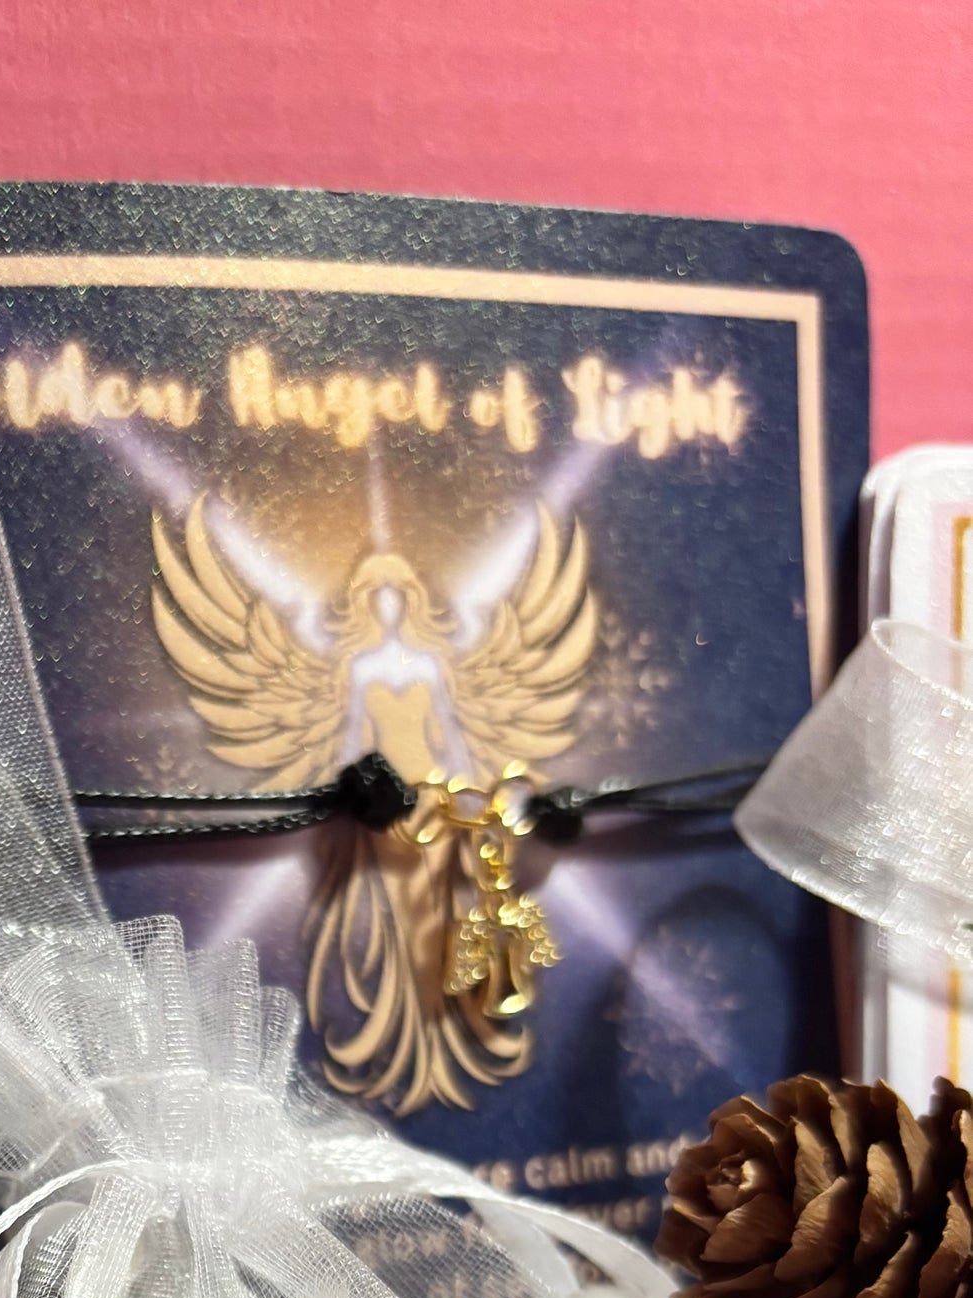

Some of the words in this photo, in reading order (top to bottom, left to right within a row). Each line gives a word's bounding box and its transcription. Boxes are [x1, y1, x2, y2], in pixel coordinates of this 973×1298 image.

[228, 345, 451, 448] Angel
[470, 366, 543, 452] of
[561, 355, 749, 460] Light
[525, 1149, 616, 1190] calm
